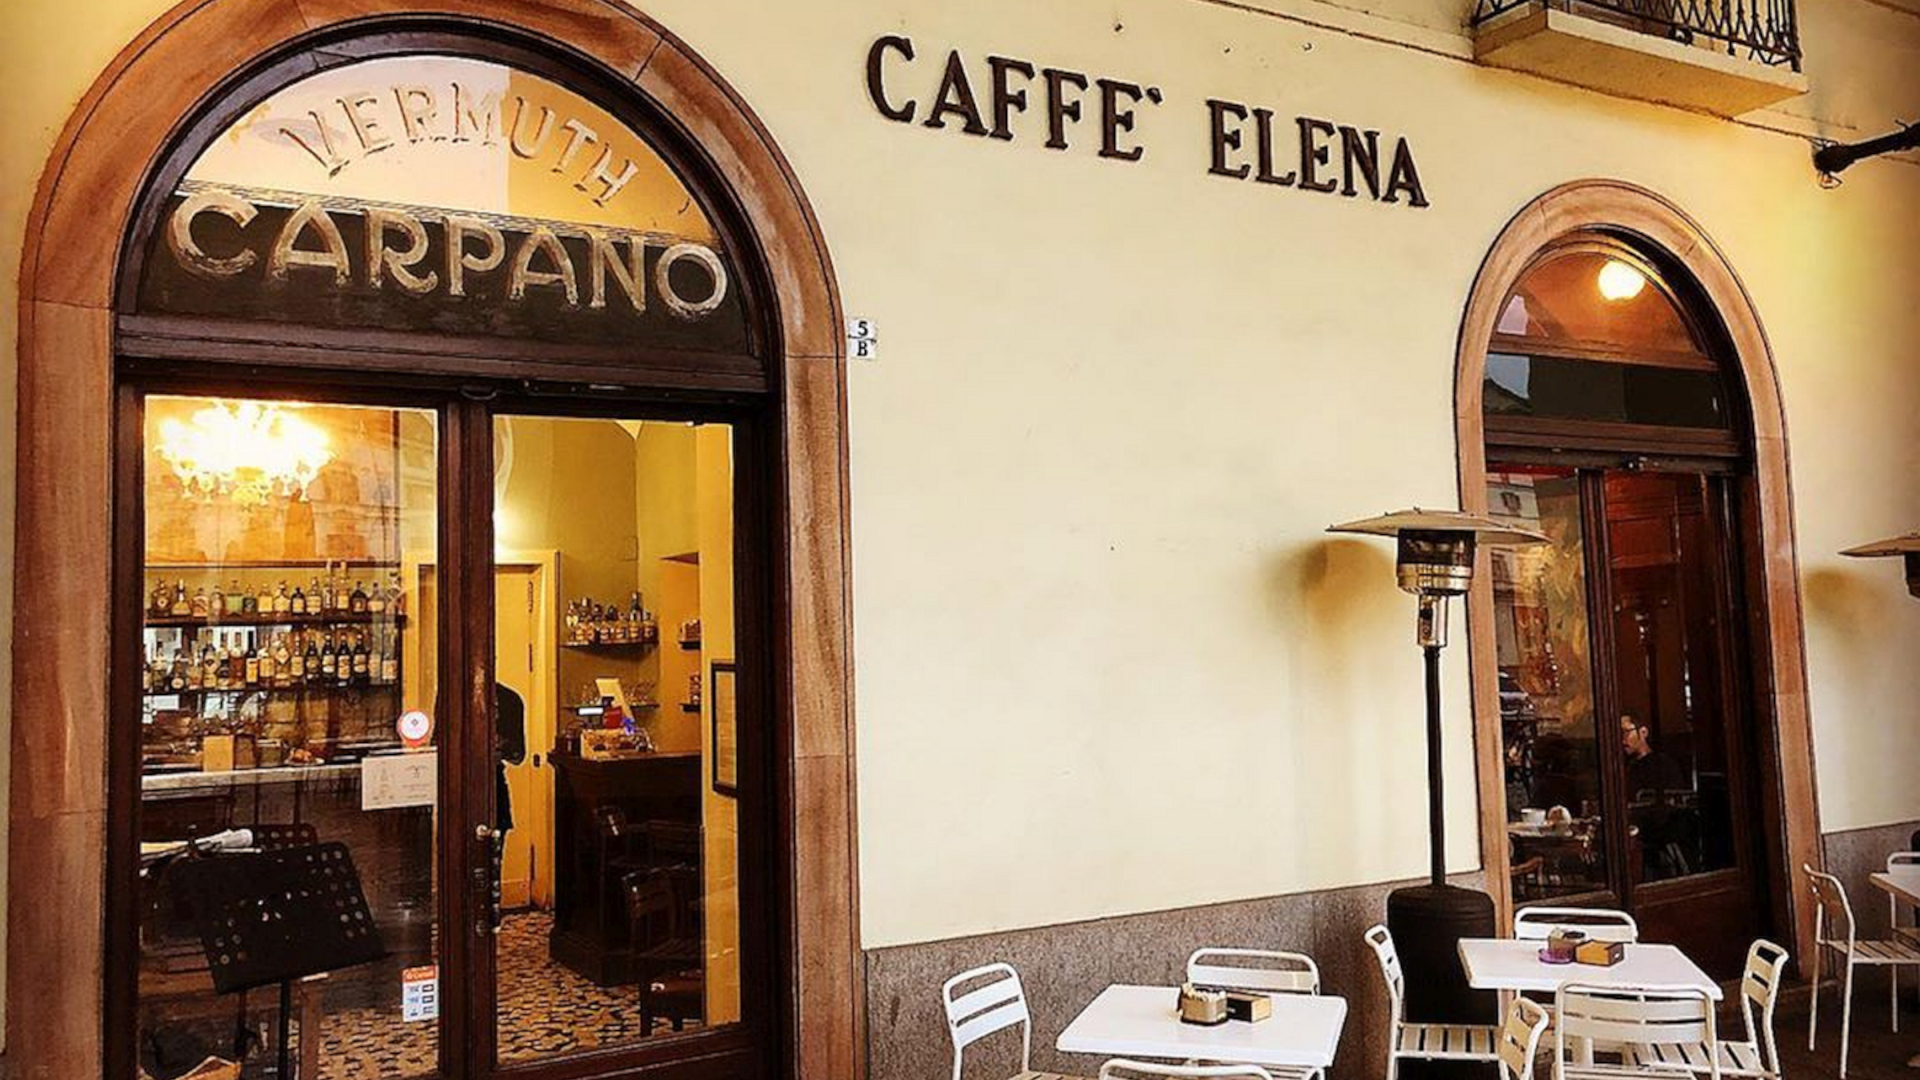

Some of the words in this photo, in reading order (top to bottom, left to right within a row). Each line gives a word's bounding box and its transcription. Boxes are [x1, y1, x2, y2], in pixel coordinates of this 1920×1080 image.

[279, 82, 639, 207] VERMUTH
[1206, 98, 1430, 208] ELENA
[166, 191, 729, 318] CARPANO
[857, 340, 868, 357] B
[858, 320, 868, 337] 5
